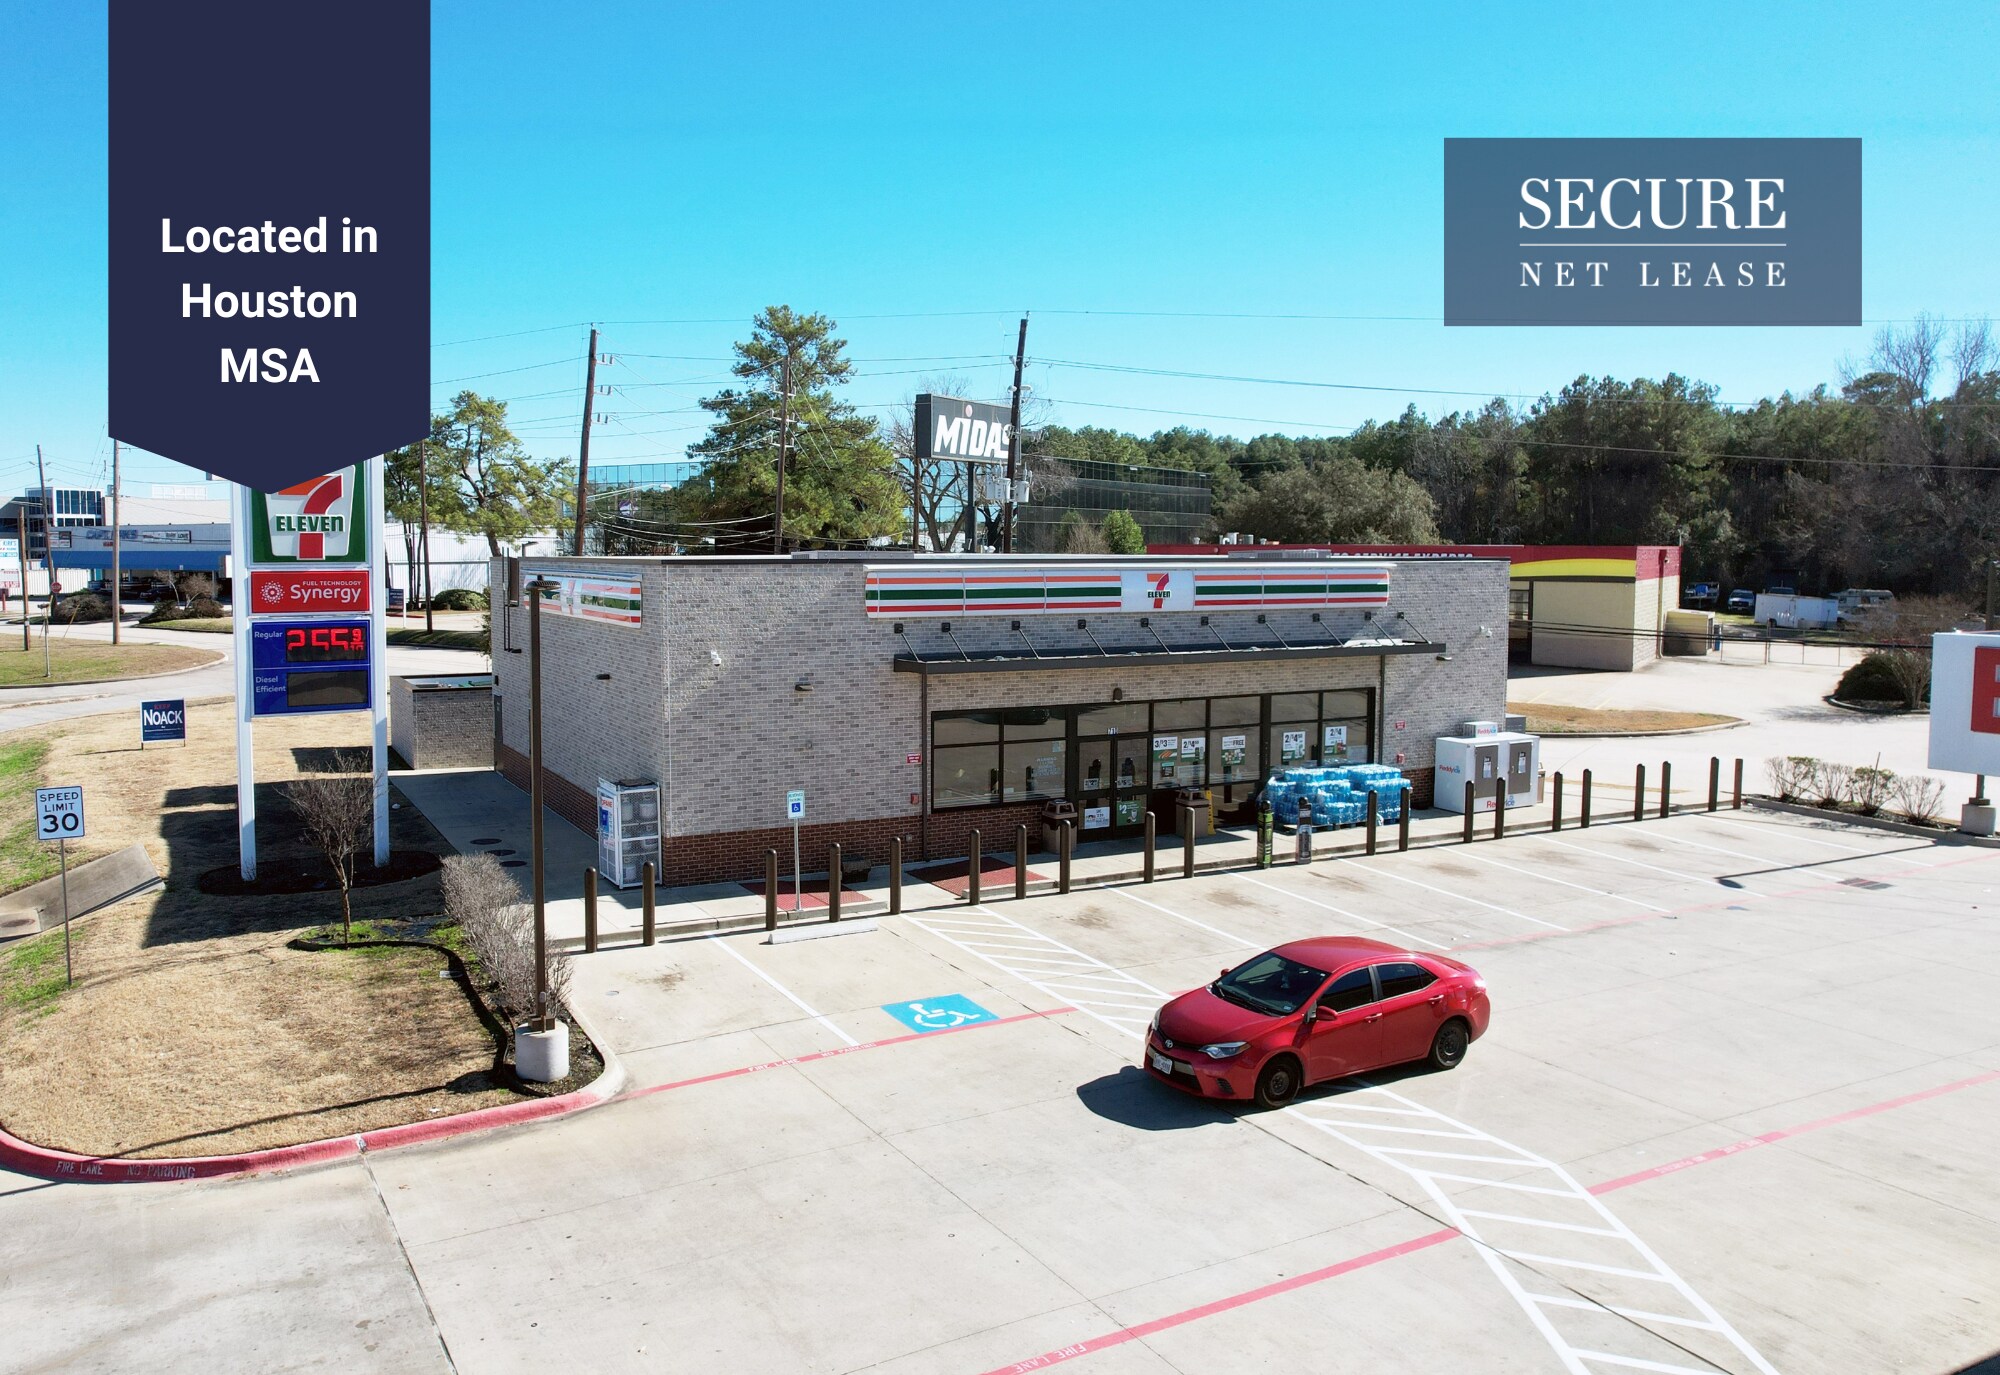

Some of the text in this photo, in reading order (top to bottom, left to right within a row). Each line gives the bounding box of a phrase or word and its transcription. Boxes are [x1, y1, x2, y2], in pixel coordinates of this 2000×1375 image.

[290, 584, 362, 604] Synergy
[254, 631, 283, 640] Regular
[255, 675, 279, 684] Diesel
[255, 685, 286, 693] Efficient
[143, 709, 183, 726] NOACK
[40, 792, 79, 802] SPEED
[45, 802, 75, 812] LIMIT
[43, 812, 79, 833] 30
[748, 1064, 770, 1073] FIRE
[774, 1058, 801, 1067] LANE
[55, 1160, 196, 1179] FIRE LANE NO PARKING
[1012, 1343, 1088, 1374] FIRE LANE
